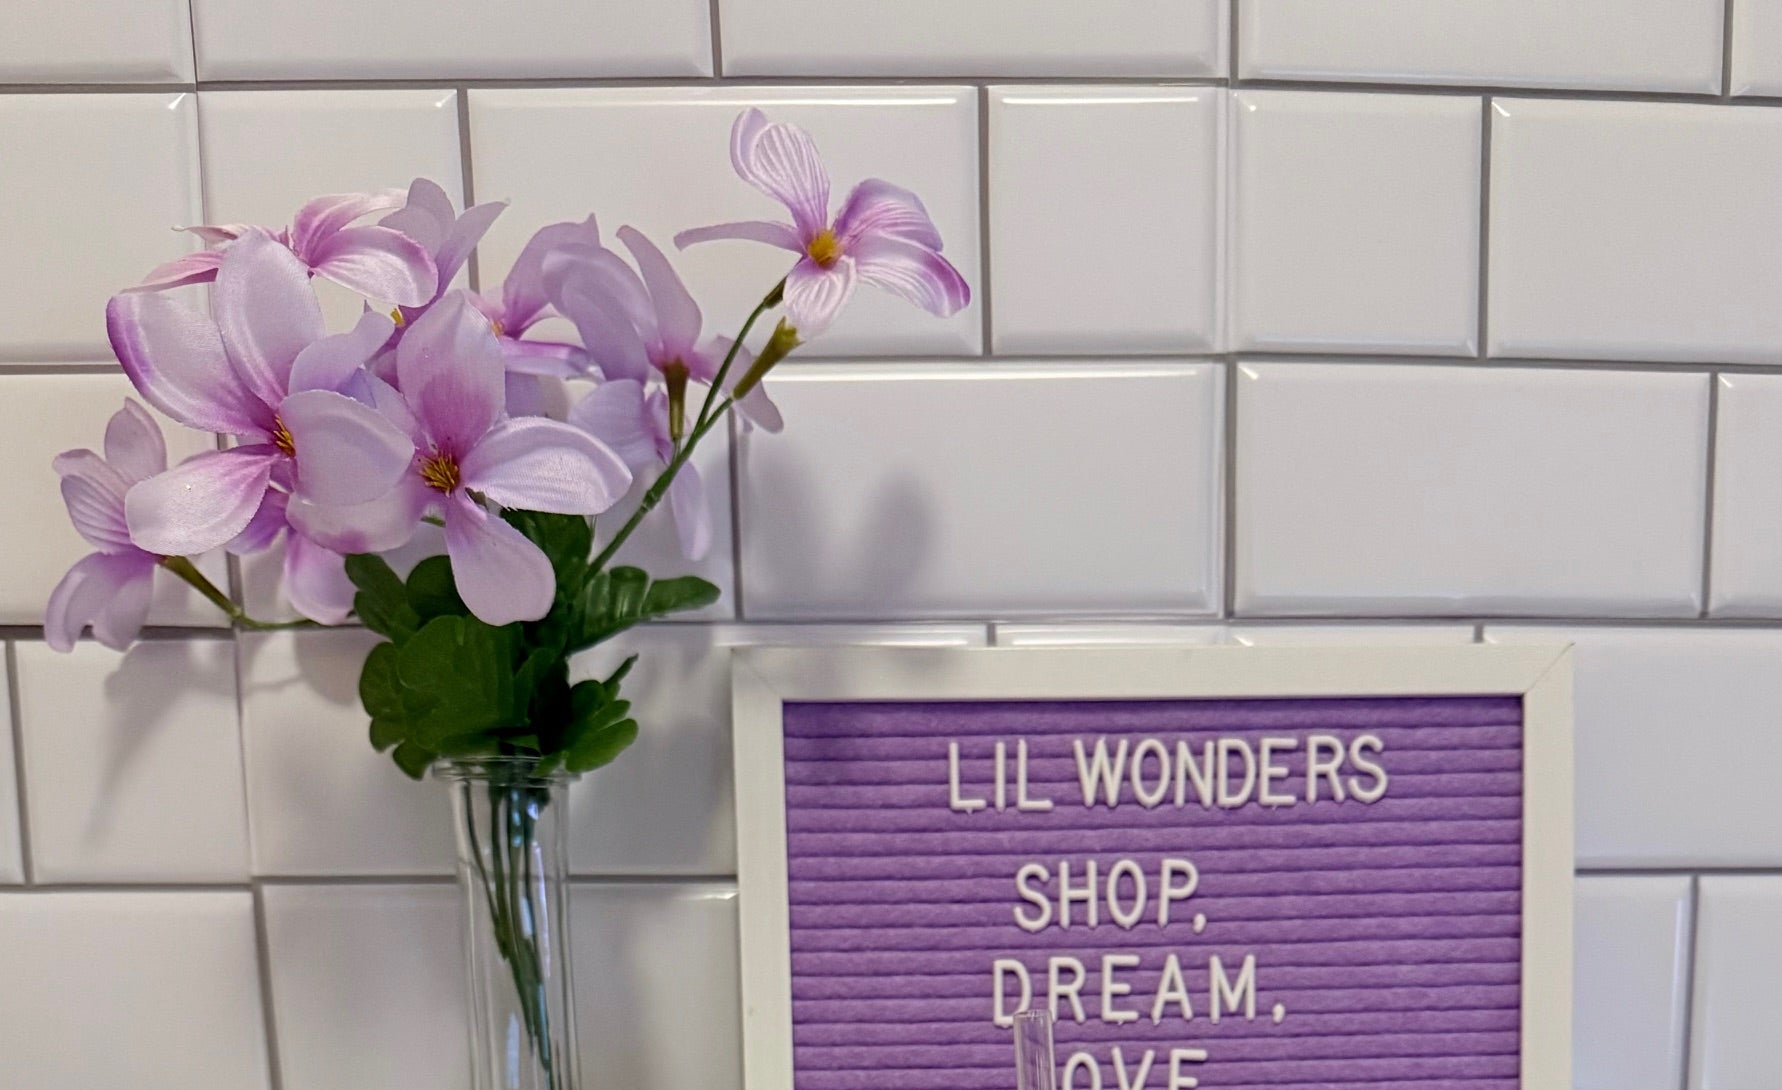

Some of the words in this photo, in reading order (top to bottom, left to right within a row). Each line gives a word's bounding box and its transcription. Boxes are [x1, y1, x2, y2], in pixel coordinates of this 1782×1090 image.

[949, 739, 1054, 812] LIL
[1074, 735, 1389, 809] WONDERS
[1013, 859, 1207, 932] SHOP,
[993, 954, 1286, 1027] DREAM,
